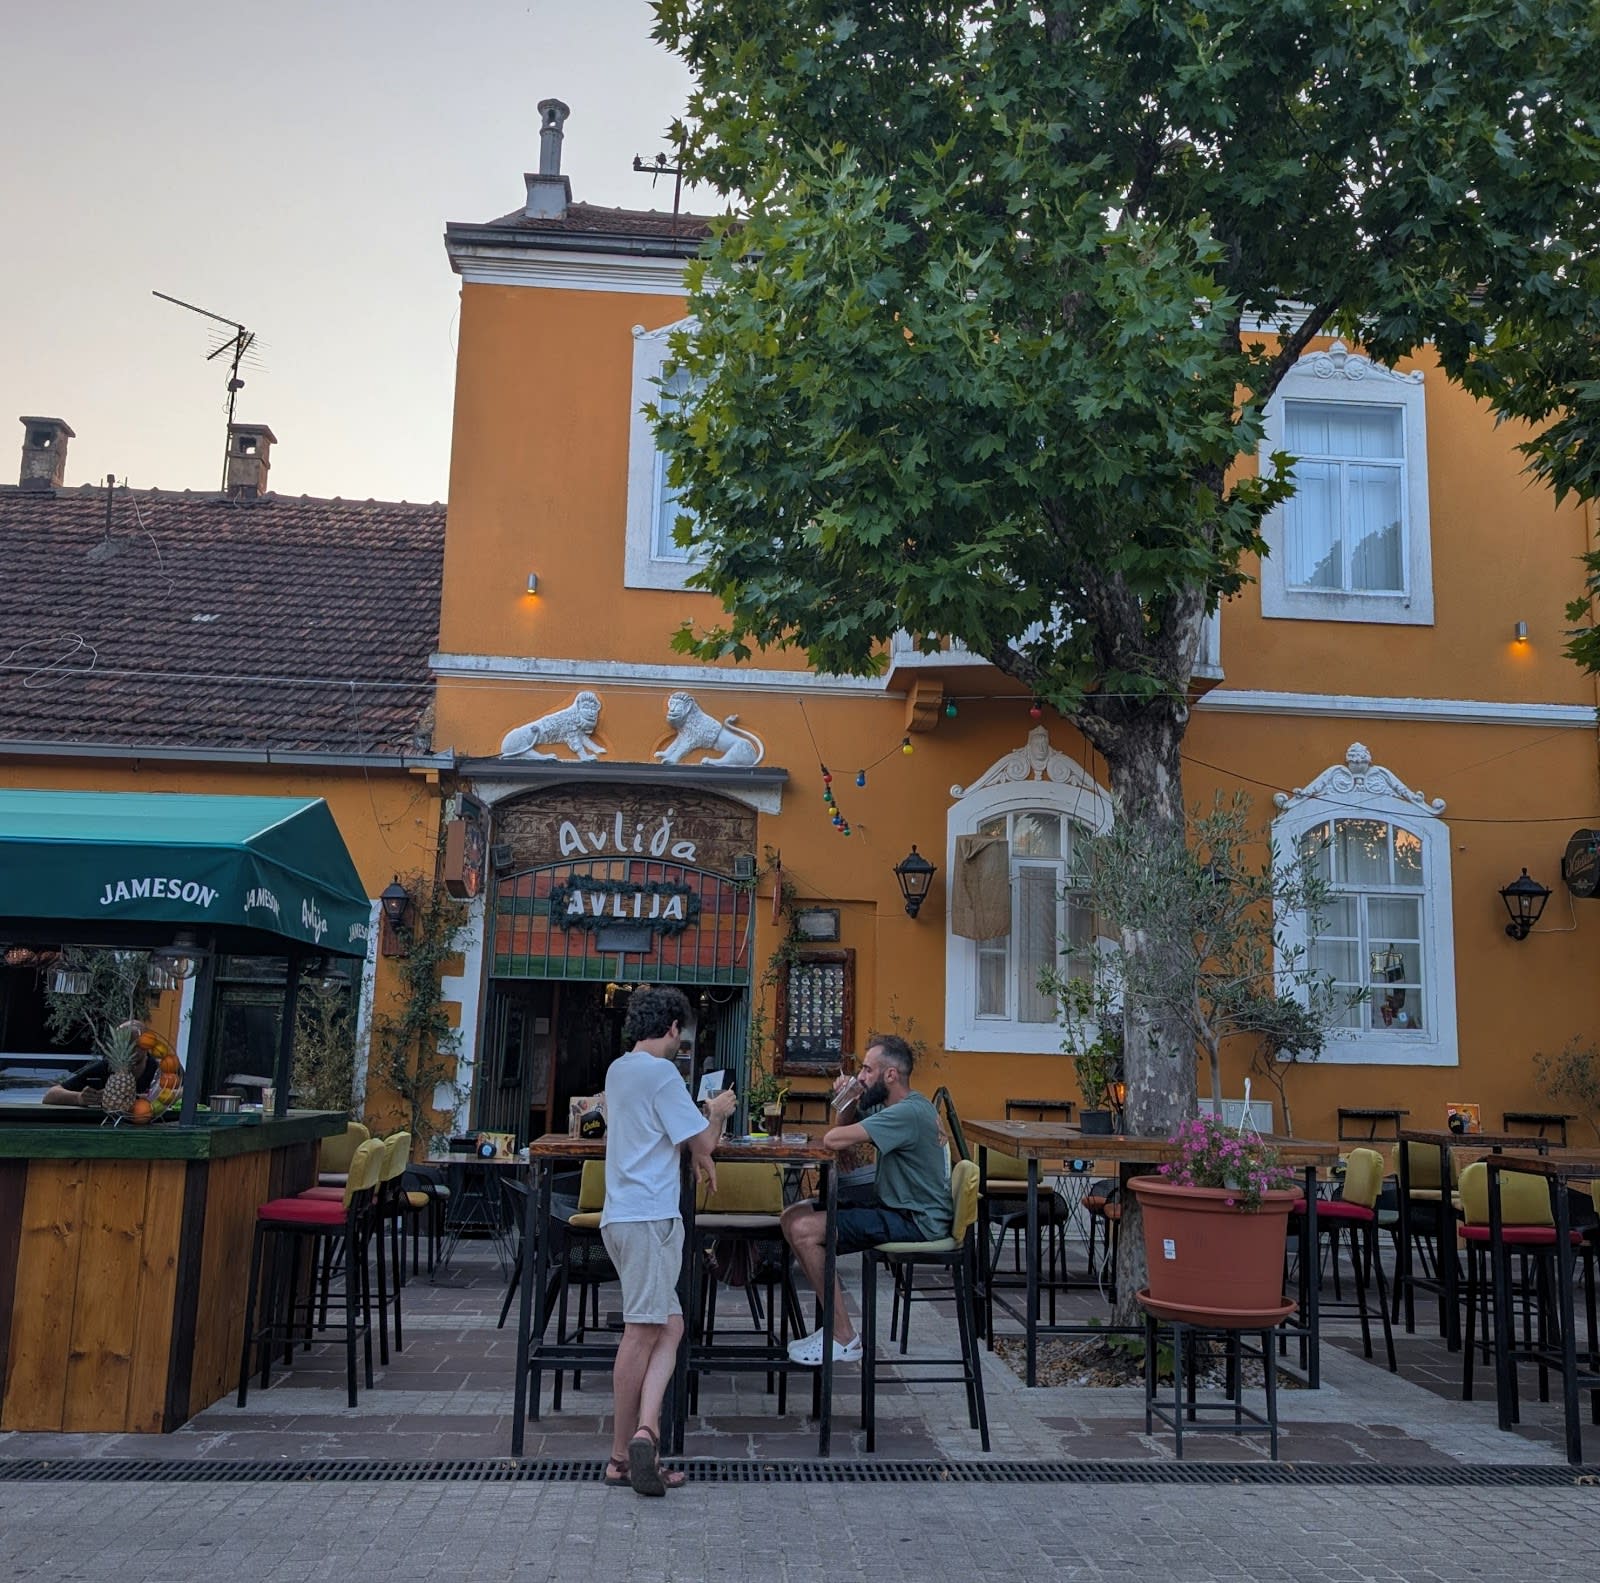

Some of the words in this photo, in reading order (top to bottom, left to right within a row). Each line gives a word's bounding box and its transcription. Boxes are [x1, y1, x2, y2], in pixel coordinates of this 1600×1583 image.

[559, 808, 697, 862] Avlija
[100, 878, 218, 908] JAMESON
[244, 888, 280, 917] JAMESON
[567, 890, 683, 920] AVLIJA
[302, 897, 328, 944] Avlija
[348, 923, 370, 943] JAMESO
